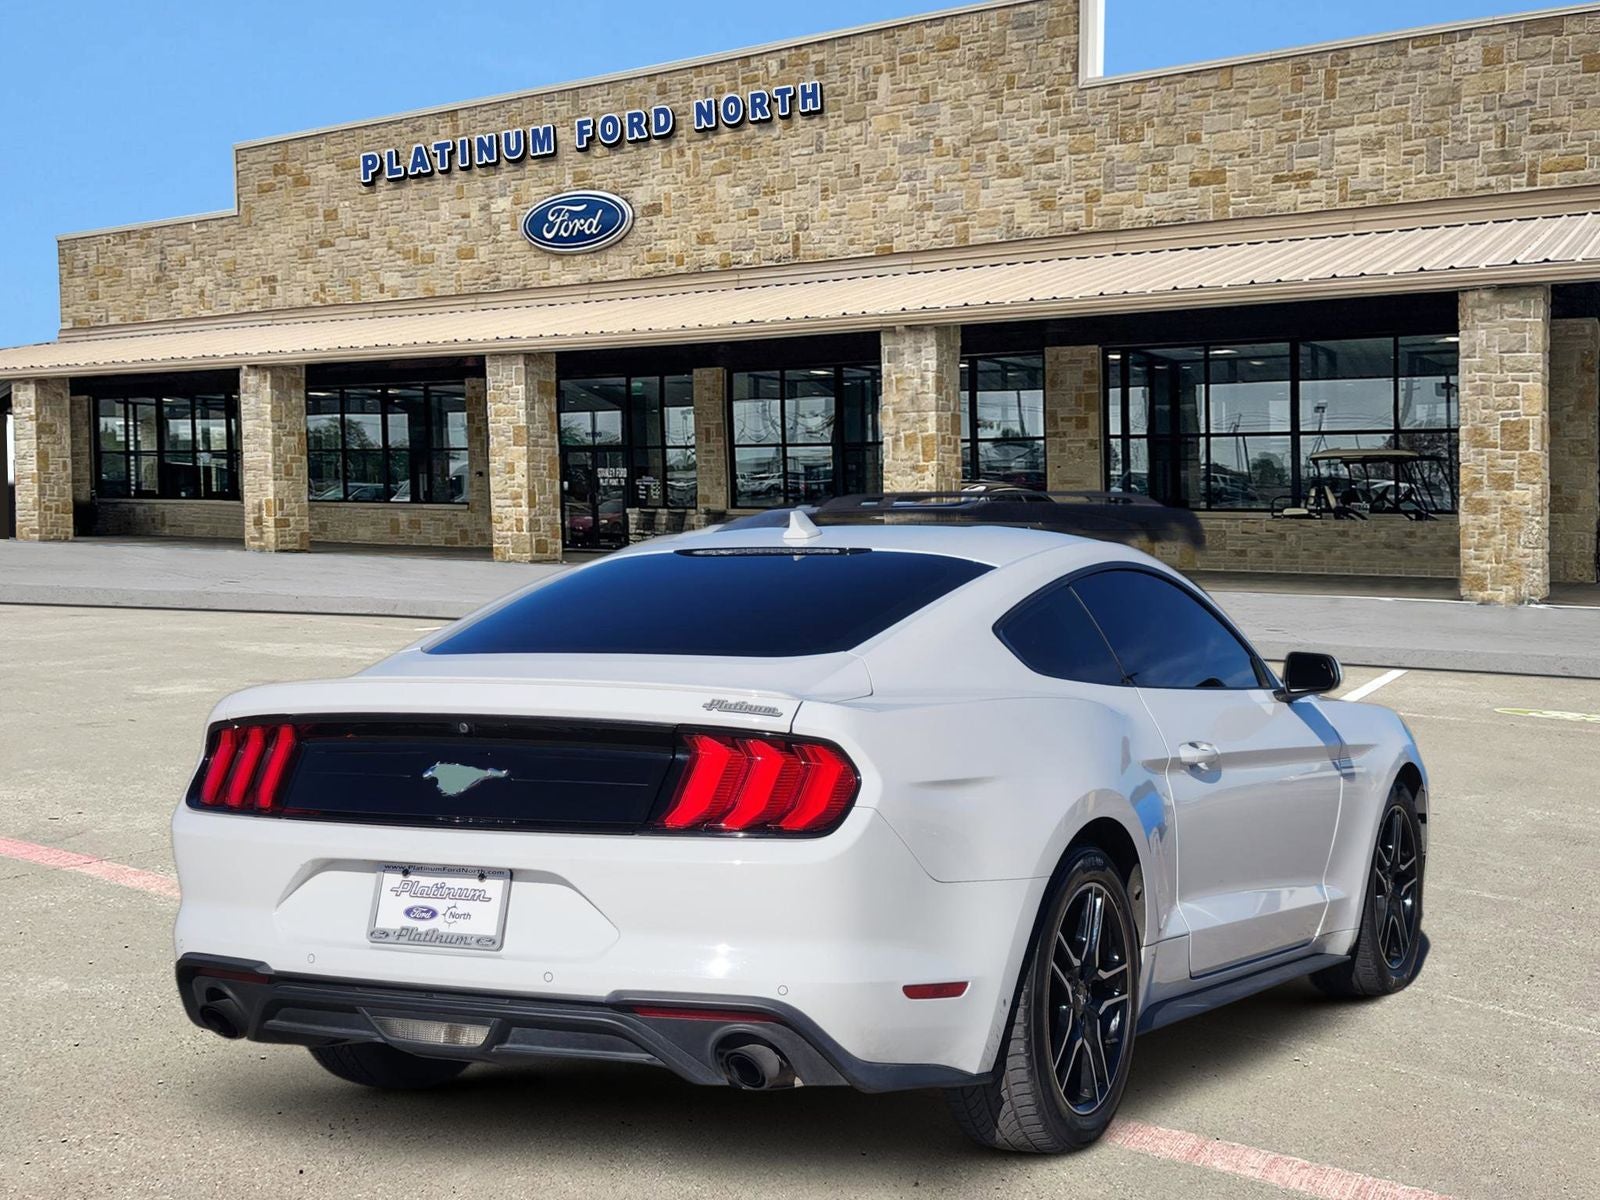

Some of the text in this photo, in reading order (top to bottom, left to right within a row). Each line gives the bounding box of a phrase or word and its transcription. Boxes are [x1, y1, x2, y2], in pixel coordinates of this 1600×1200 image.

[360, 81, 821, 184] PLATINUM FORD NORTH
[543, 204, 603, 239] Ford
[702, 699, 783, 717] Platinum
[384, 864, 505, 876] www.PlatinumFordNorth.com
[390, 880, 492, 902] Platinum
[411, 906, 472, 921] Ford North
[396, 926, 473, 945] Platinum
